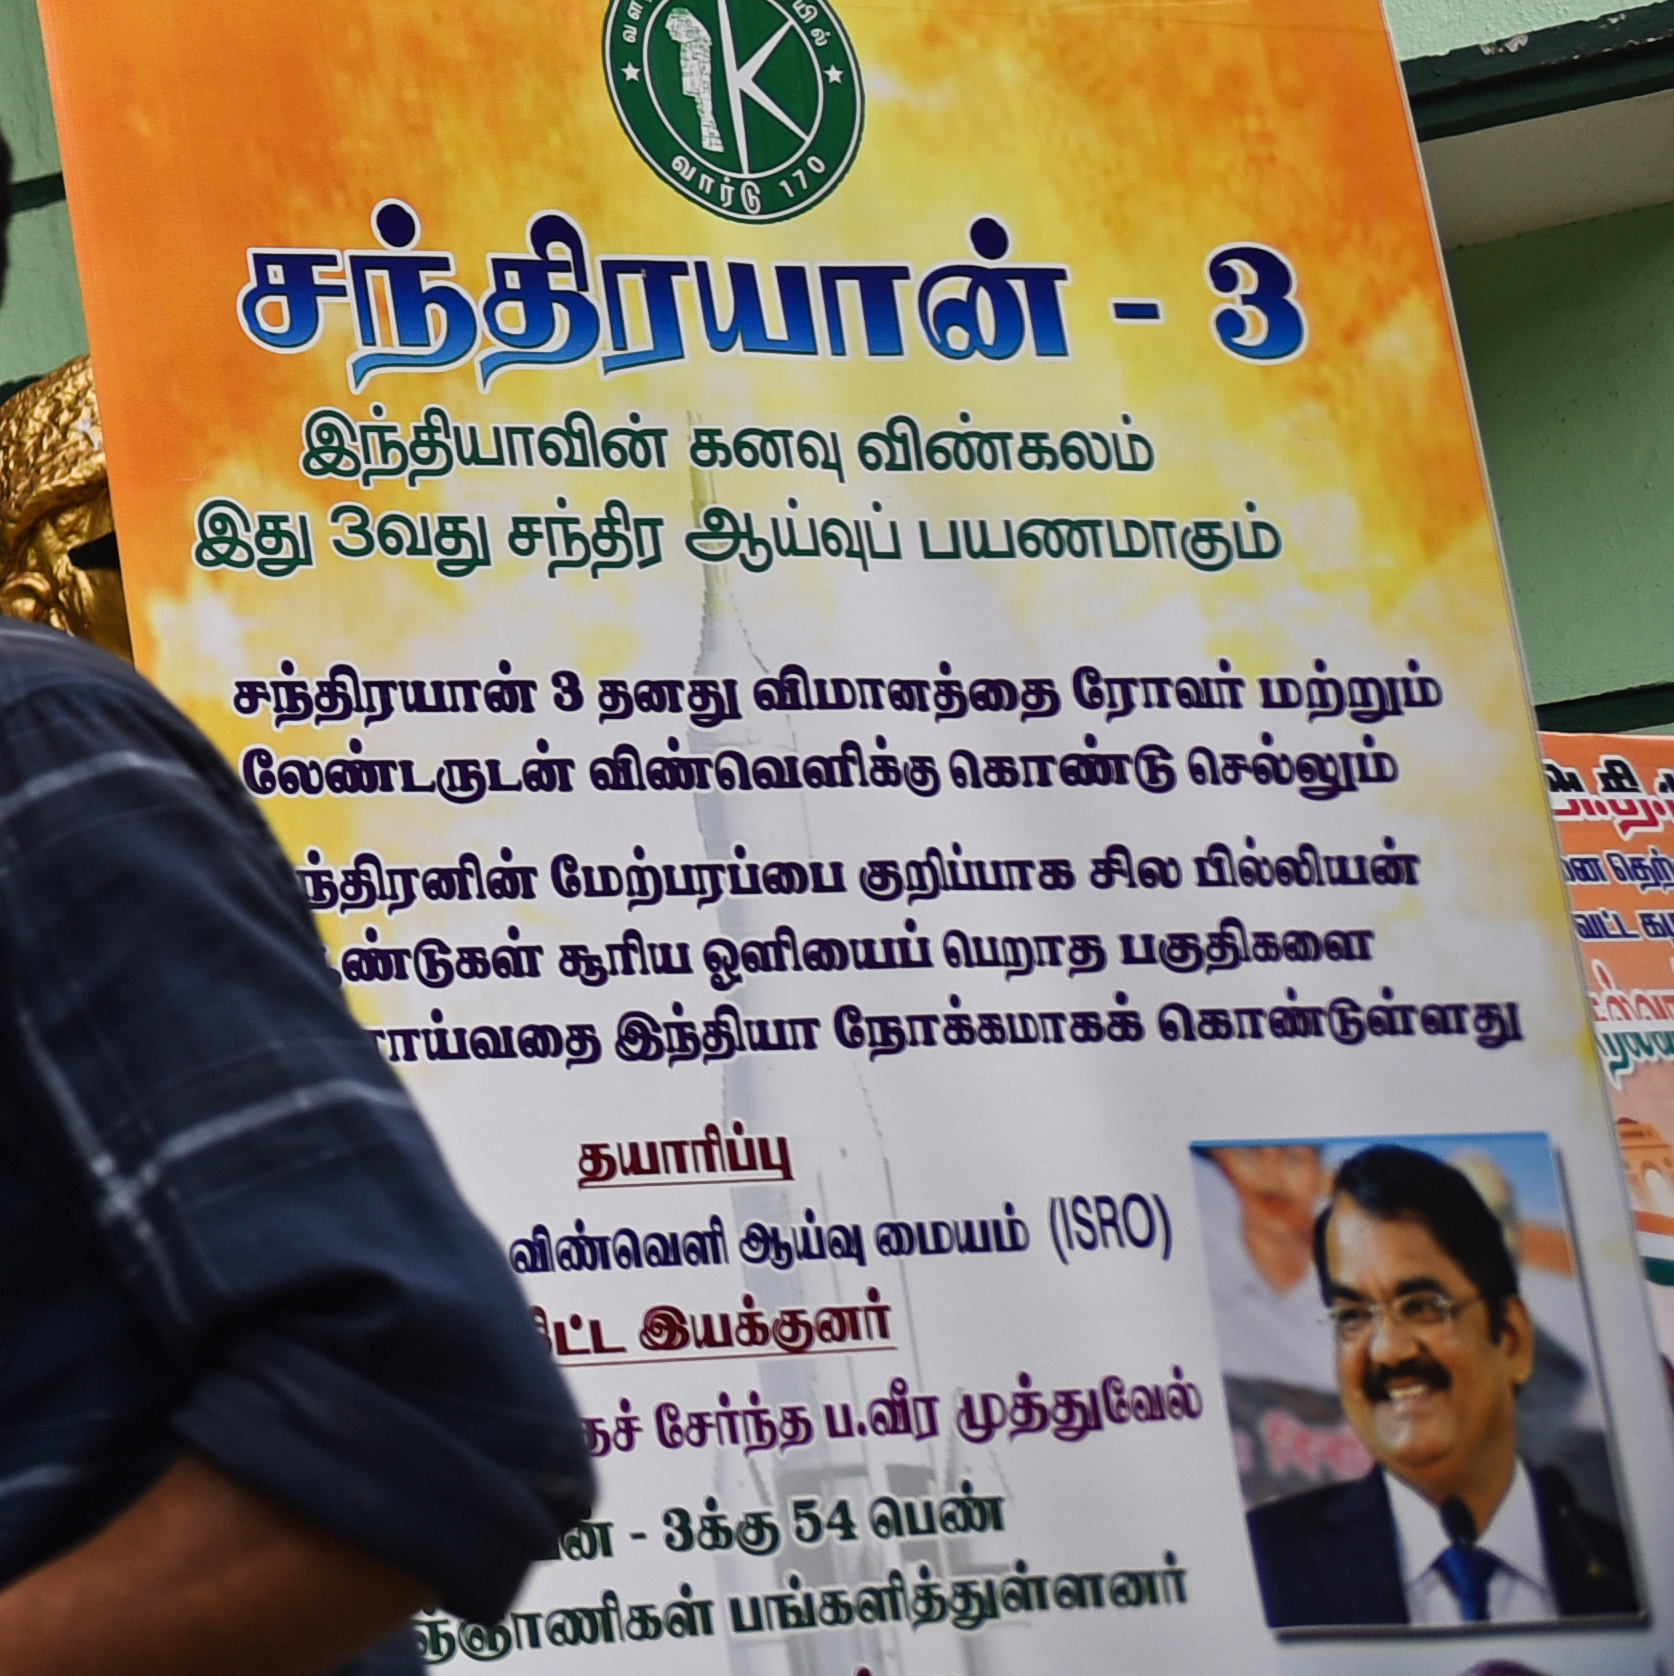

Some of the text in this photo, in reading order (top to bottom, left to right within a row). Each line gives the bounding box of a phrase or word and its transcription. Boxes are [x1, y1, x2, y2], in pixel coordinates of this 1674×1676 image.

[779, 156, 825, 198] 170
[244, 198, 1068, 387] சந்திரயான்
[1209, 245, 1305, 362] 3
[303, 402, 1153, 486] இந்தியாவின் கனவு விண்கலம்
[196, 499, 1280, 575] இது 3வது சந்திர ஆய்வுப் பயணமாகும்
[234, 659, 1443, 727] சந்திரயான் 3 தனது விமானத்தை ரோவர் மற்றும்
[242, 733, 1398, 803] லேண்டருடன் விண்வெளிக்கு கொண்டு செல்லும்
[295, 836, 1421, 915] ந்திரனின் மேற்பரப்பை குறிப்பாக சில பில்லியன்
[328, 925, 543, 988] ண்டுகள்
[559, 929, 693, 986] சூரிய
[942, 931, 1106, 982] பெறாத
[1120, 917, 1372, 974] பகுதிகளை
[616, 1001, 819, 1068] இந்தியா
[833, 992, 1143, 1061] நோக்கமாகக்
[1158, 986, 1524, 1048] கொண்டுள்ளது
[578, 1122, 792, 1182] தயாரிப்பு
[740, 1208, 866, 1271] ஆய்வு
[876, 1202, 1029, 1256] மையம்
[1050, 1192, 1172, 1263] (ISRO)
[639, 1287, 892, 1353] இயக்குனர்
[656, 1391, 812, 1454] சேர்ந்த
[825, 1378, 938, 1442] ப.வீர
[956, 1366, 1202, 1442] முத்துவேல்
[662, 1495, 782, 1556] 3க்கு
[793, 1498, 860, 1544] 54
[871, 1480, 1006, 1539] பெண்
